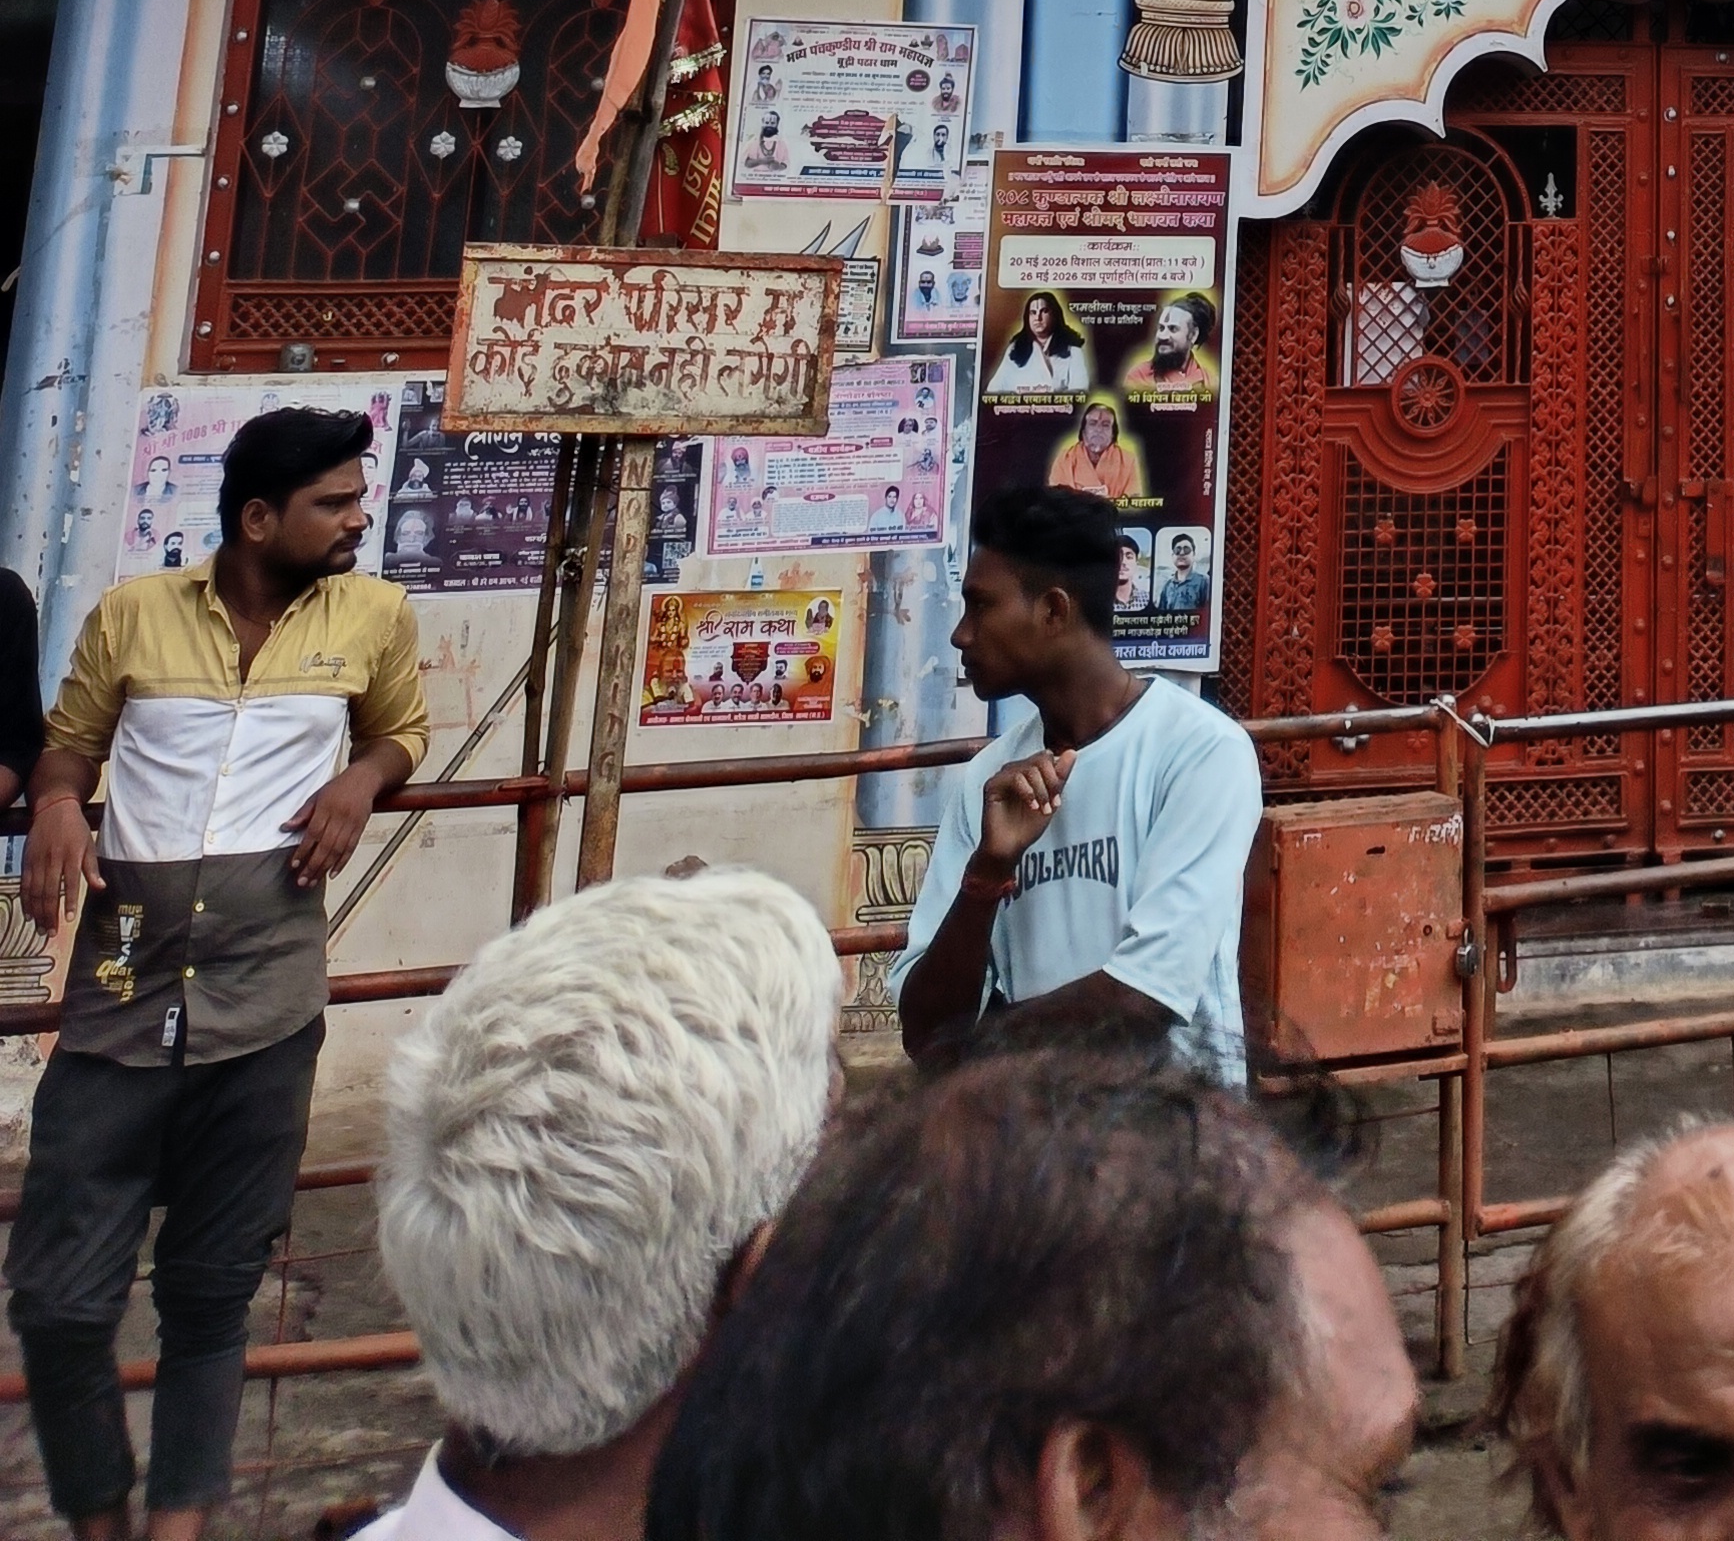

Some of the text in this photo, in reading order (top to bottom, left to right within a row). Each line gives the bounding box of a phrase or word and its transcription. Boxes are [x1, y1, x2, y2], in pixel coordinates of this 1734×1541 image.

[864, 38, 877, 52] श्री
[879, 42, 897, 55] राम
[1107, 184, 1128, 206] श्री
[1056, 207, 1081, 229] एवं
[1183, 212, 1216, 228] कथा
[1009, 254, 1198, 268] 20 मई 2026 विशाल बजे
[1020, 272, 1033, 282] 26
[1035, 269, 1050, 283] मई
[1052, 272, 1078, 282] 2026
[1161, 272, 1168, 282] 4
[1170, 269, 1187, 282] बजे
[469, 326, 540, 397] कोई
[181, 425, 208, 443] 1008
[723, 619, 755, 638] राम
[760, 619, 796, 637] कथा
[1002, 835, 1120, 911] OULEVARD
